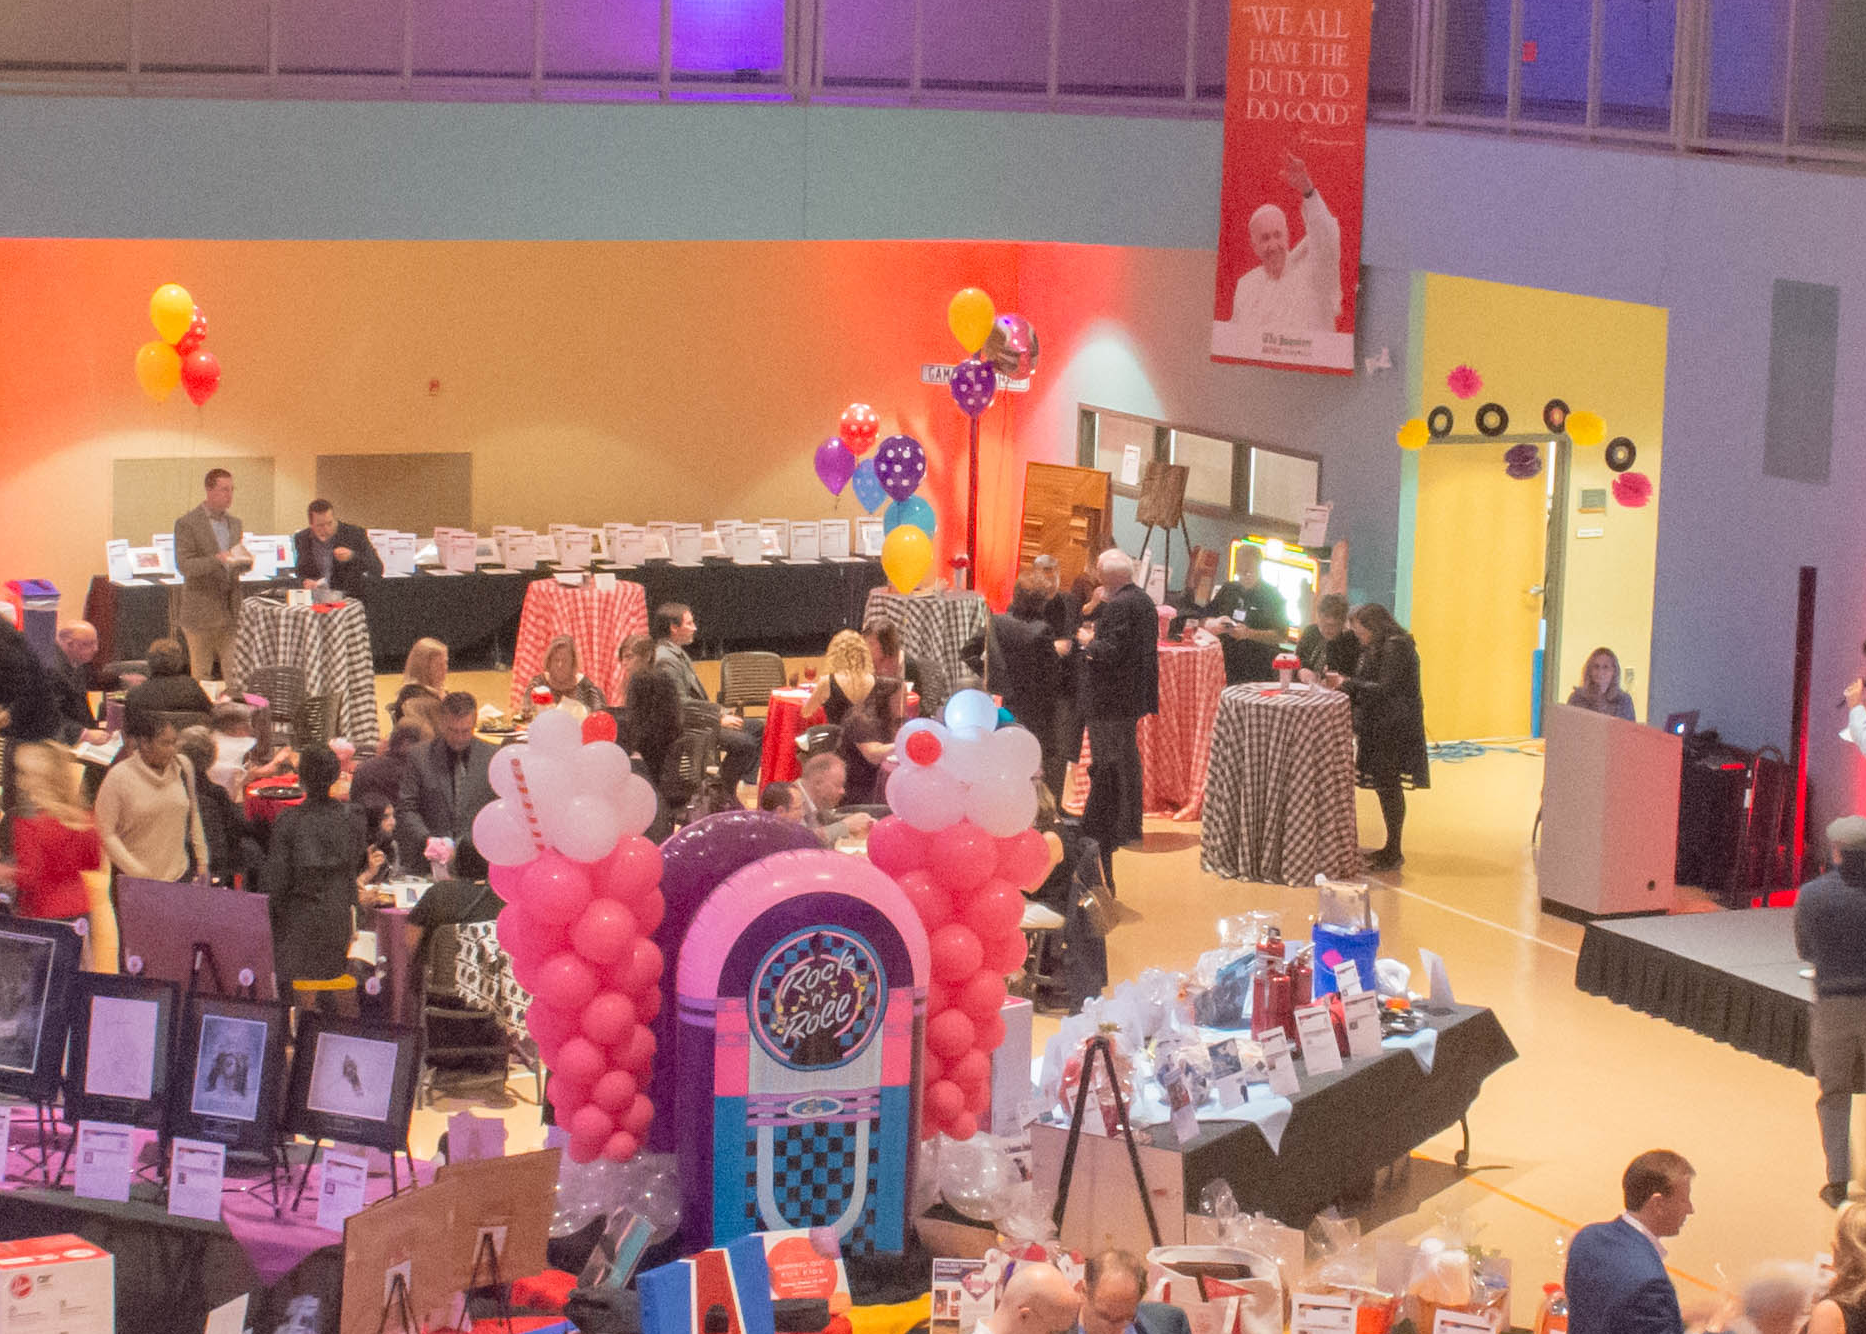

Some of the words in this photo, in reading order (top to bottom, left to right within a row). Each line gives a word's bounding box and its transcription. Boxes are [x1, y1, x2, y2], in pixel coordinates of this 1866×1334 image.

[1300, 10, 1349, 38] ALL
[1249, 40, 1302, 64] HAVE
[1309, 43, 1350, 67] THE
[1249, 69, 1311, 96] DUTY
[1318, 73, 1350, 98] TO
[1247, 98, 1280, 121] DO
[782, 948, 856, 1000] Rock
[783, 993, 851, 1044] Roll
